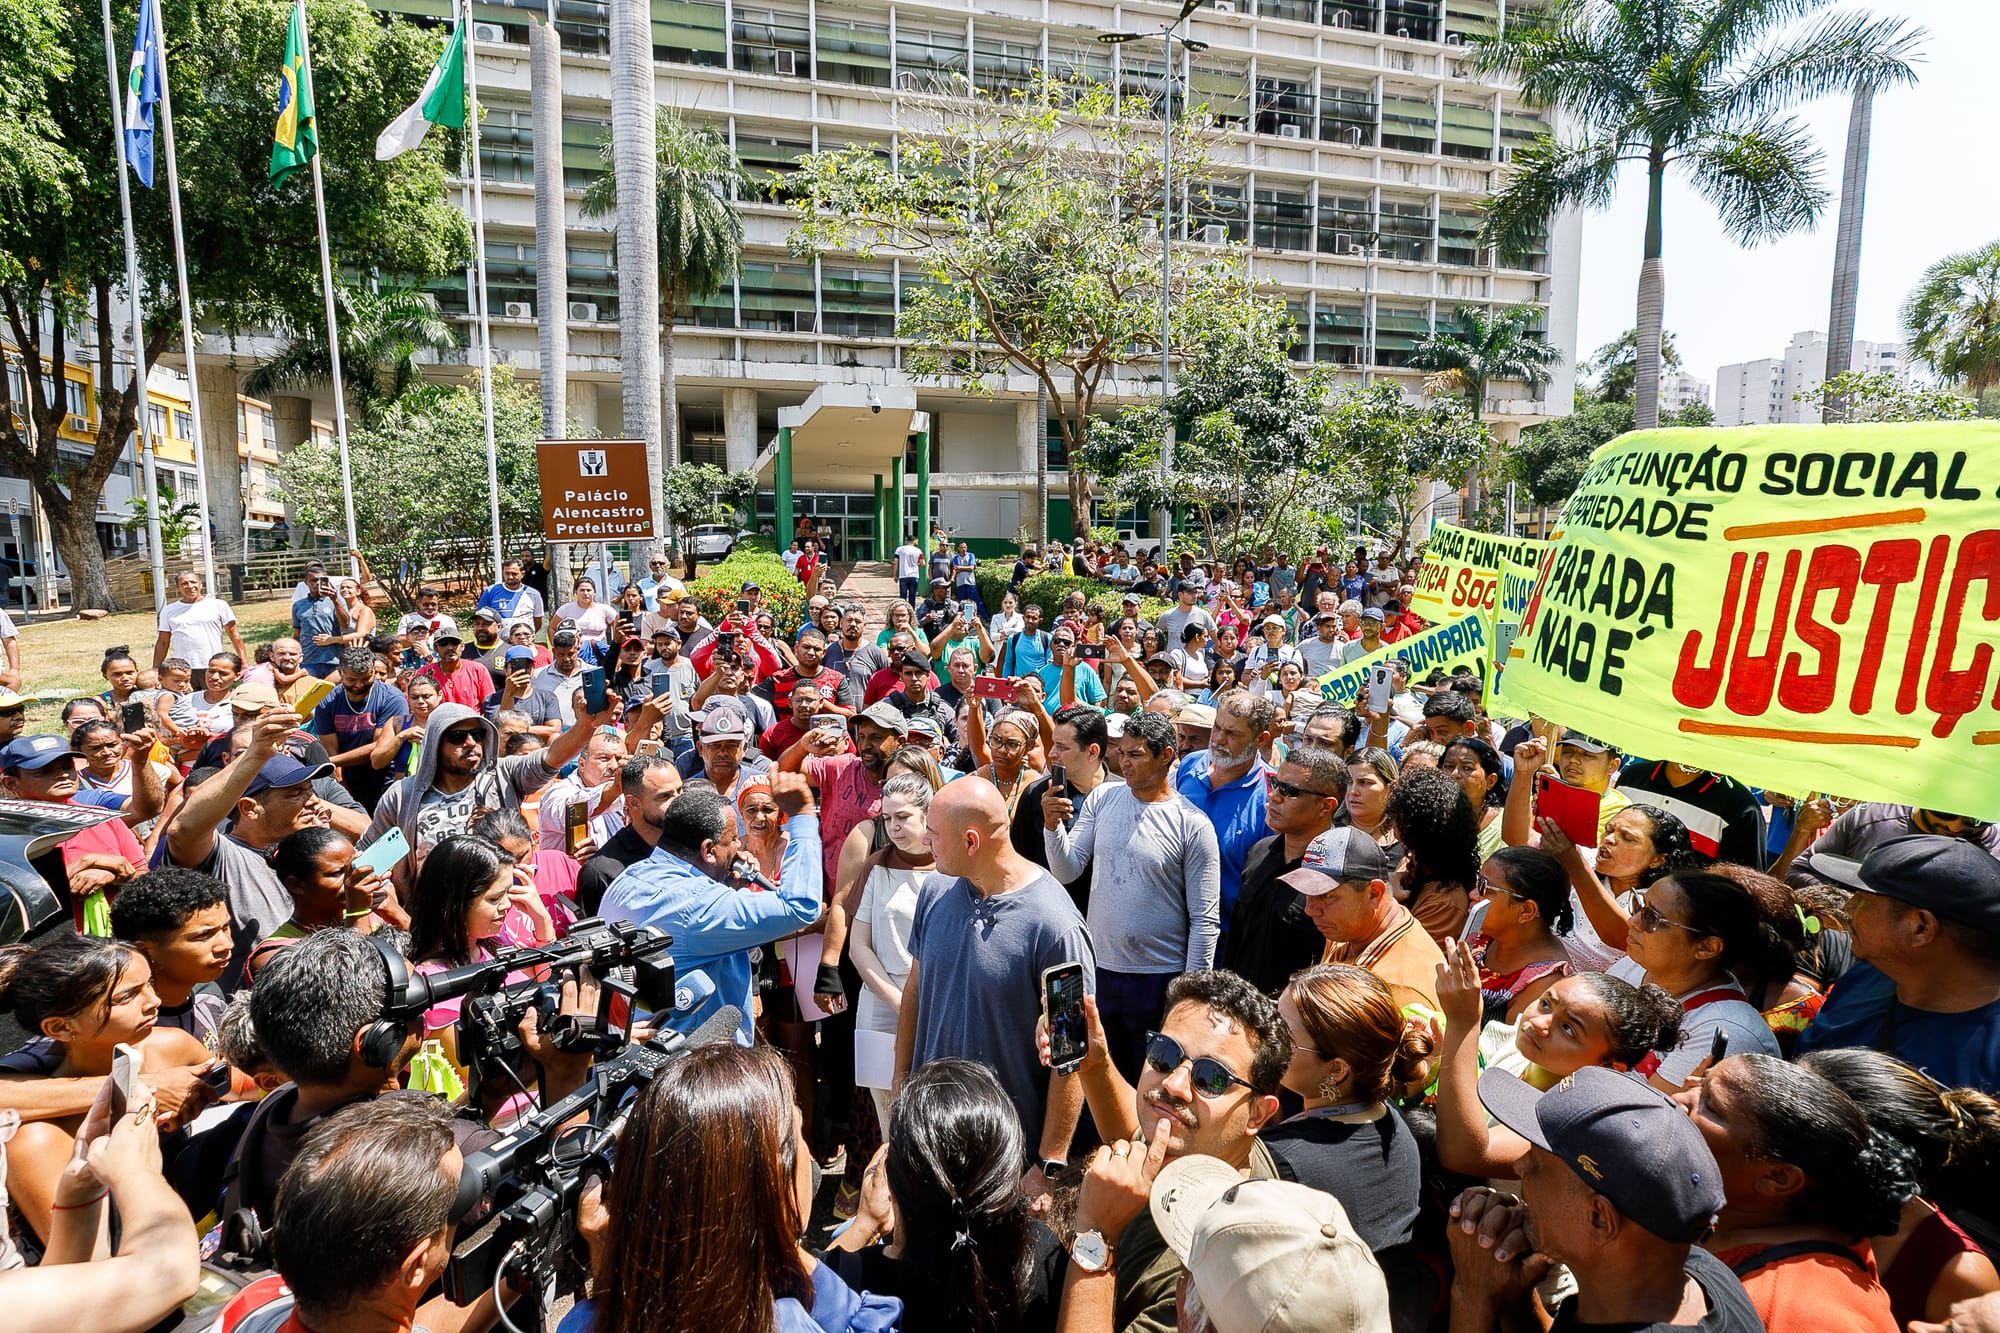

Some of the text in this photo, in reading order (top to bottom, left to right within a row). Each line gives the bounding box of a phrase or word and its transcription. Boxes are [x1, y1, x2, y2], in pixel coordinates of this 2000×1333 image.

[564, 489, 628, 502] Palácio
[1759, 451, 1981, 500] SOCIAL
[552, 506, 645, 519] Alencastro
[556, 522, 643, 535] Prefeitura
[1452, 567, 1497, 610] SOC
[1546, 544, 1675, 629] PARADA
[1672, 529, 2000, 738] JUSTIÇ
[1600, 625, 1655, 696] É
